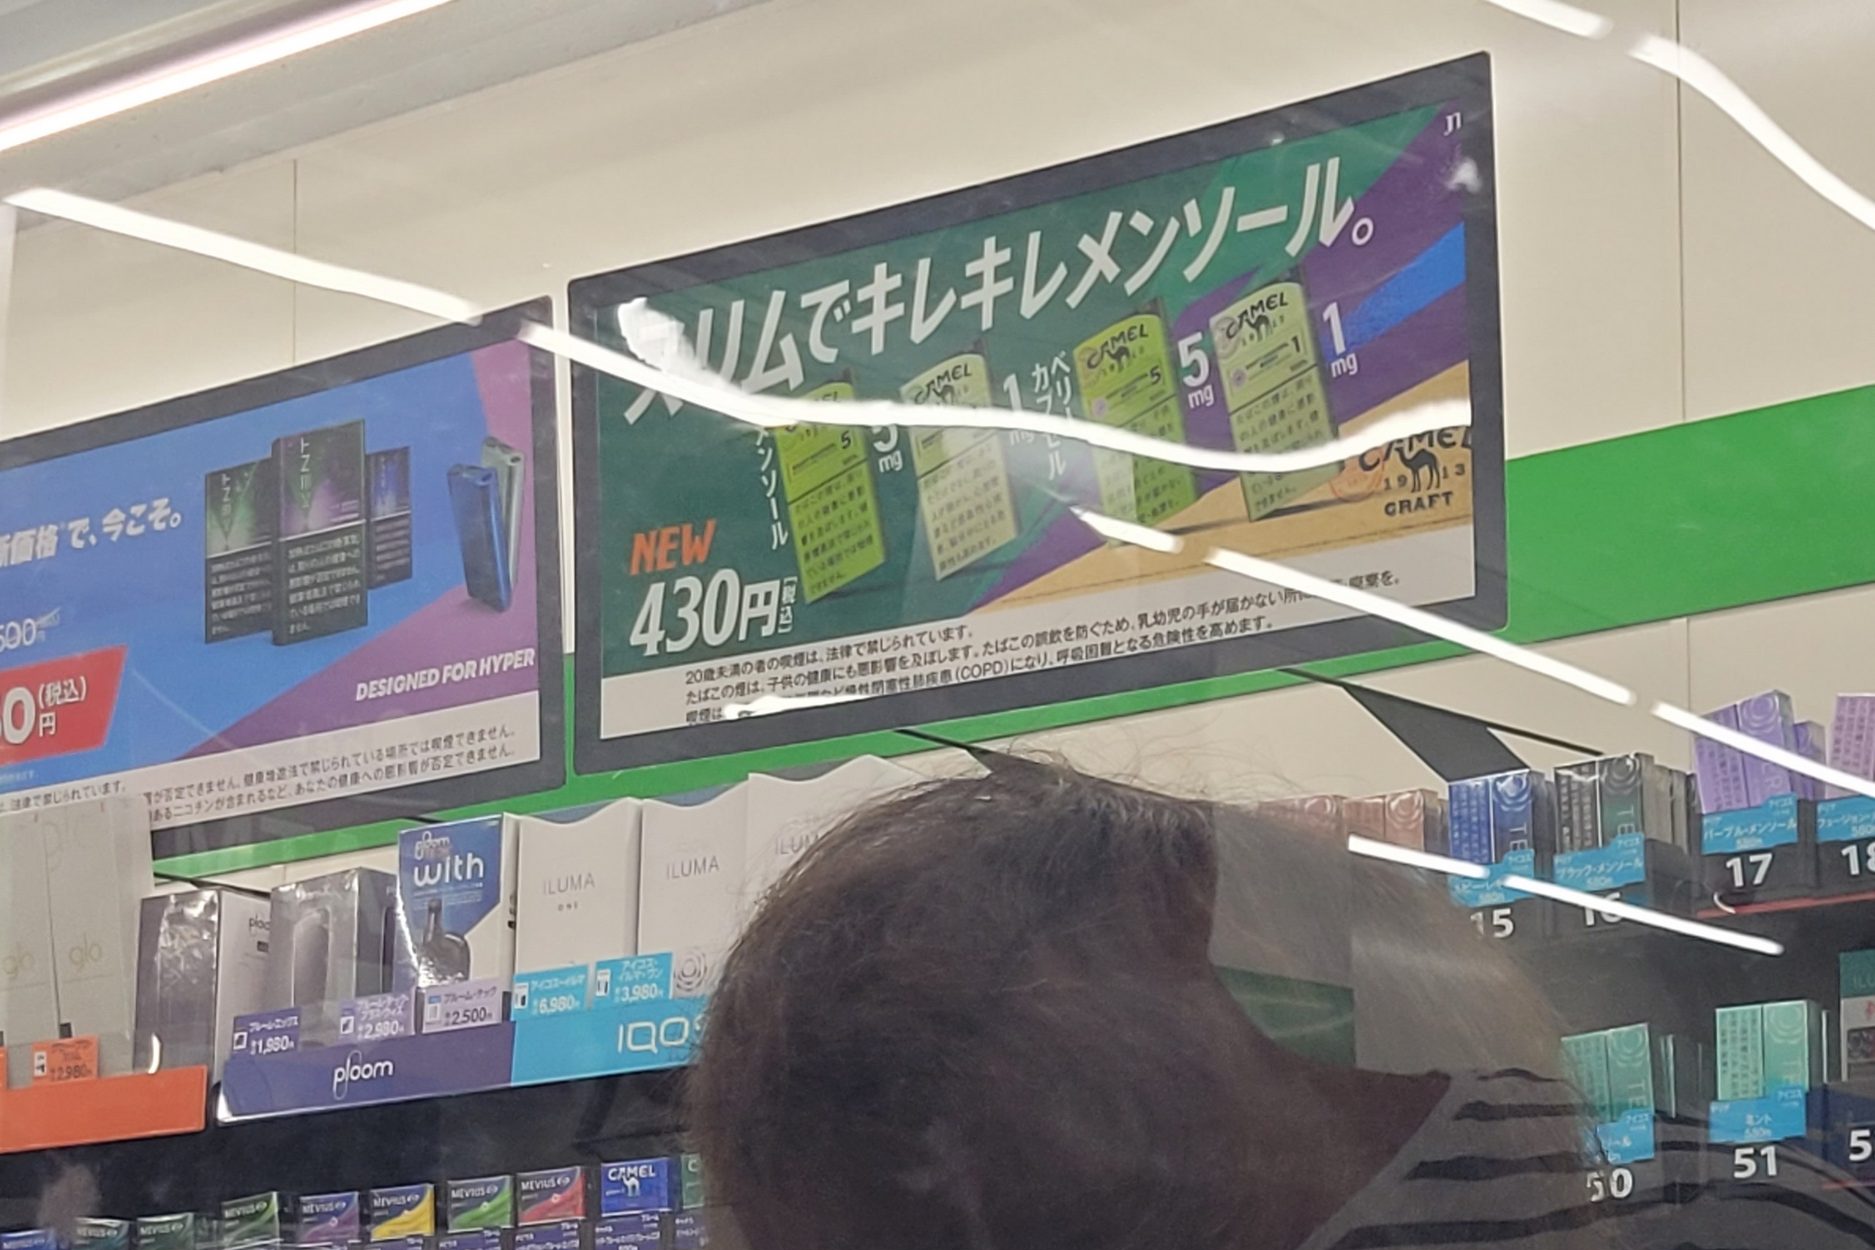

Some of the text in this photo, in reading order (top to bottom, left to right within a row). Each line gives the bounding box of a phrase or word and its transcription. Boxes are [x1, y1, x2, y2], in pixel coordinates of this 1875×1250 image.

[1225, 291, 1289, 339] CAMEL
[1322, 302, 1346, 355] 1
[1087, 323, 1149, 369] CAMEL
[1178, 332, 1210, 387] 5
[1331, 353, 1358, 377] mg
[1188, 384, 1215, 408] mg
[878, 450, 903, 473] mg
[629, 518, 717, 576] NEW
[629, 568, 780, 658] 430円
[355, 647, 535, 702] DESIGNED FOR HYPER
[38, 711, 57, 737] 円
[413, 853, 485, 886] with
[543, 874, 596, 895] ILUMA
[666, 856, 719, 880] ILUMA
[1726, 852, 1773, 888] 17
[1470, 907, 1514, 938] 15
[333, 1050, 394, 1100] ploom
[1733, 1145, 1778, 1179] 51
[1849, 1129, 1875, 1162] 5
[520, 1177, 556, 1192] MEVIUS
[608, 1166, 656, 1181] CAMEL
[1586, 1167, 1634, 1202] 50
